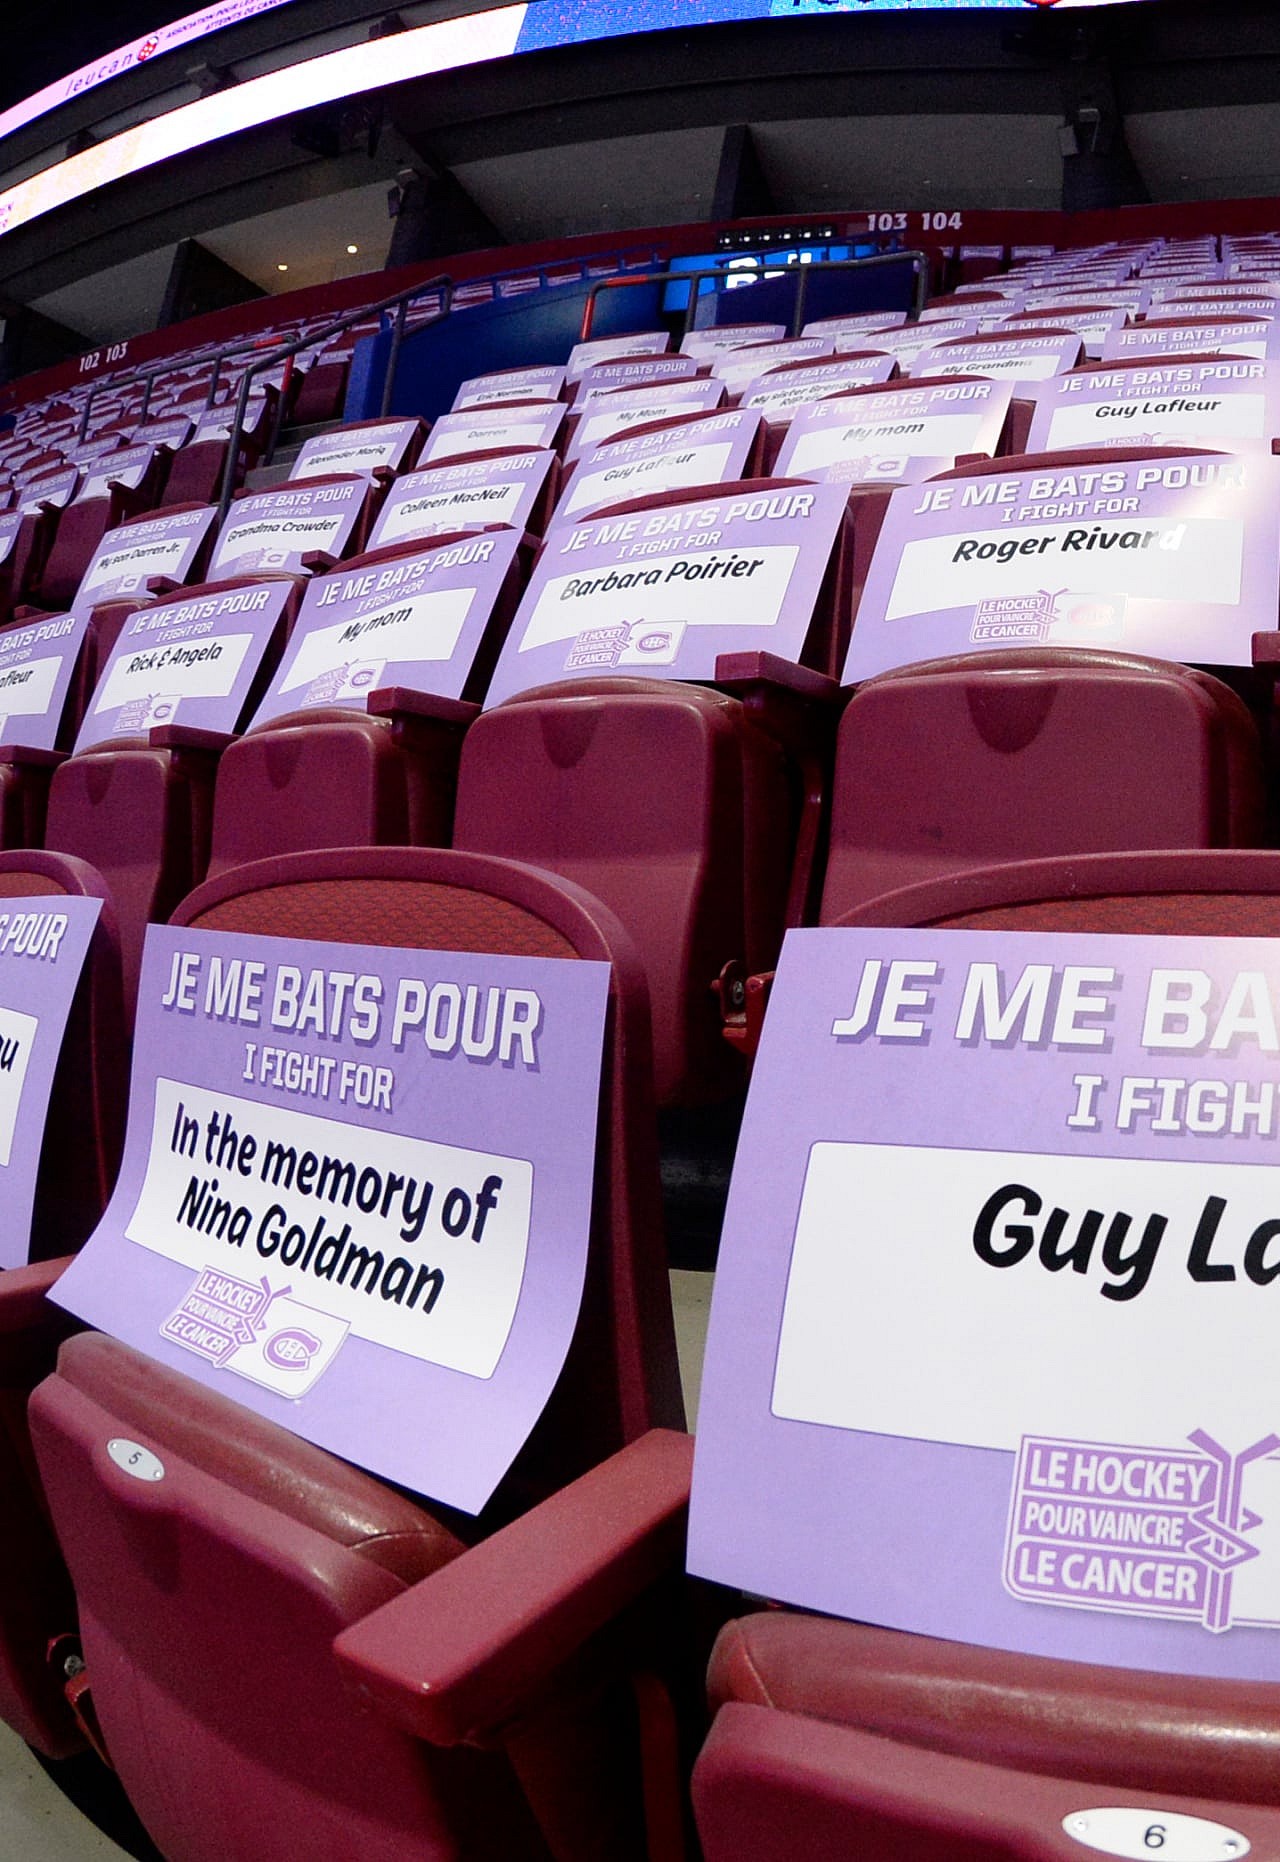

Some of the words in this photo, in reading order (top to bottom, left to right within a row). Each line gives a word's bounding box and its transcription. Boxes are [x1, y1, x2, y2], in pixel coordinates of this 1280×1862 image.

[65, 52, 132, 96] leucan
[867, 213, 907, 231] 103
[921, 213, 962, 230] 104
[79, 353, 100, 372] 102
[105, 342, 128, 361] 103
[942, 364, 967, 375] My
[1095, 404, 1138, 418] Guy
[1142, 399, 1222, 413] Lafleur
[842, 426, 875, 442] My
[876, 422, 925, 436] mom
[604, 466, 635, 482] Guy
[914, 488, 954, 515] JE
[961, 481, 1020, 509] ME
[1029, 470, 1129, 500] BATS
[1137, 463, 1247, 490] POUR
[400, 495, 452, 515] Colleen
[450, 487, 511, 505] MacNeil
[1001, 508, 1013, 524] I
[1018, 500, 1090, 521] FIGHT
[1093, 497, 1139, 514] FOR
[227, 521, 280, 542] Grandma
[282, 519, 337, 532] Crowder
[560, 527, 593, 554] JE
[595, 519, 640, 545] ME
[643, 503, 722, 537] BATS
[723, 493, 816, 525] POUR
[952, 535, 1056, 564] Roger
[1060, 524, 1187, 553] Rivard
[616, 545, 627, 560] I
[627, 536, 688, 558] FIGHT
[687, 531, 722, 549] FOR
[560, 568, 664, 601] Barbara
[666, 554, 764, 583] Poirier
[34, 618, 75, 642] POUR
[337, 622, 365, 644] My
[363, 607, 413, 633] mom
[126, 653, 156, 674] Rick
[170, 642, 223, 668] Angela
[4, 914, 68, 959] POUR
[162, 952, 201, 1008] JE
[205, 956, 265, 1023] ME
[271, 965, 386, 1044] BATS
[391, 978, 543, 1066] POUR
[831, 959, 940, 1042] JE
[954, 962, 1120, 1048] ME
[242, 1043, 258, 1082] I
[261, 1048, 337, 1102] FIGHT
[340, 1063, 395, 1110] FOR
[1066, 1074, 1105, 1130] I
[171, 1102, 200, 1158] In
[206, 1110, 256, 1175] the
[262, 1138, 433, 1243] memory
[442, 1175, 502, 1243] of
[176, 1175, 252, 1246] Nina
[256, 1204, 445, 1314] Goldman
[972, 1183, 1168, 1301] Guy
[202, 1272, 218, 1293] LE
[212, 1277, 262, 1314] HOCKEY
[168, 1315, 186, 1335] LE
[180, 1320, 232, 1356] CANCER
[128, 1451, 141, 1465] 5
[1029, 1449, 1066, 1490] LE
[1070, 1453, 1211, 1503] HOCKEY
[1023, 1501, 1085, 1537] POUR
[1089, 1508, 1184, 1548] VAINCRE
[1018, 1547, 1060, 1586] LE
[1061, 1552, 1199, 1602] CANCER
[1143, 1824, 1167, 1849] 6
